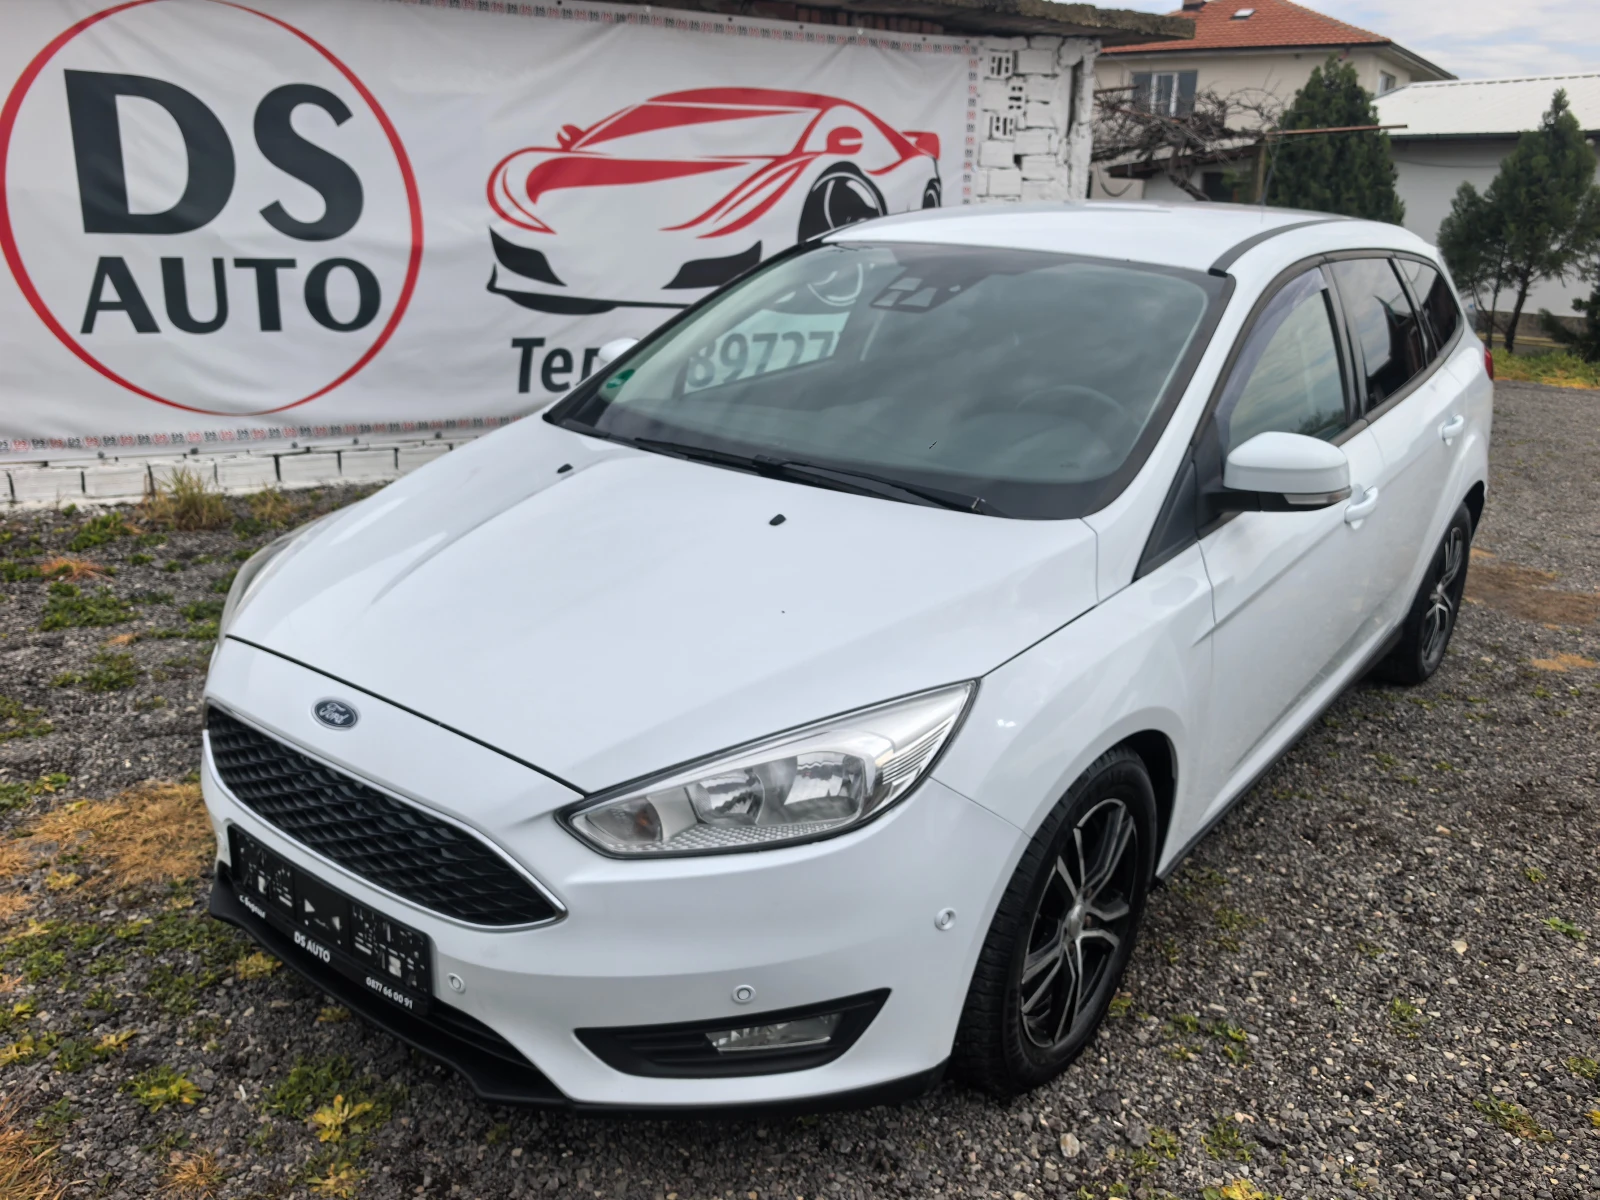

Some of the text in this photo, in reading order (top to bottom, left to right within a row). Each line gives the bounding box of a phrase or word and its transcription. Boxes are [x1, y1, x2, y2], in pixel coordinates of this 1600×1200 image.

[64, 69, 364, 242] DS
[80, 257, 381, 334] AUTO
[319, 702, 350, 724] Ford
[294, 931, 331, 963] DS AUTO
